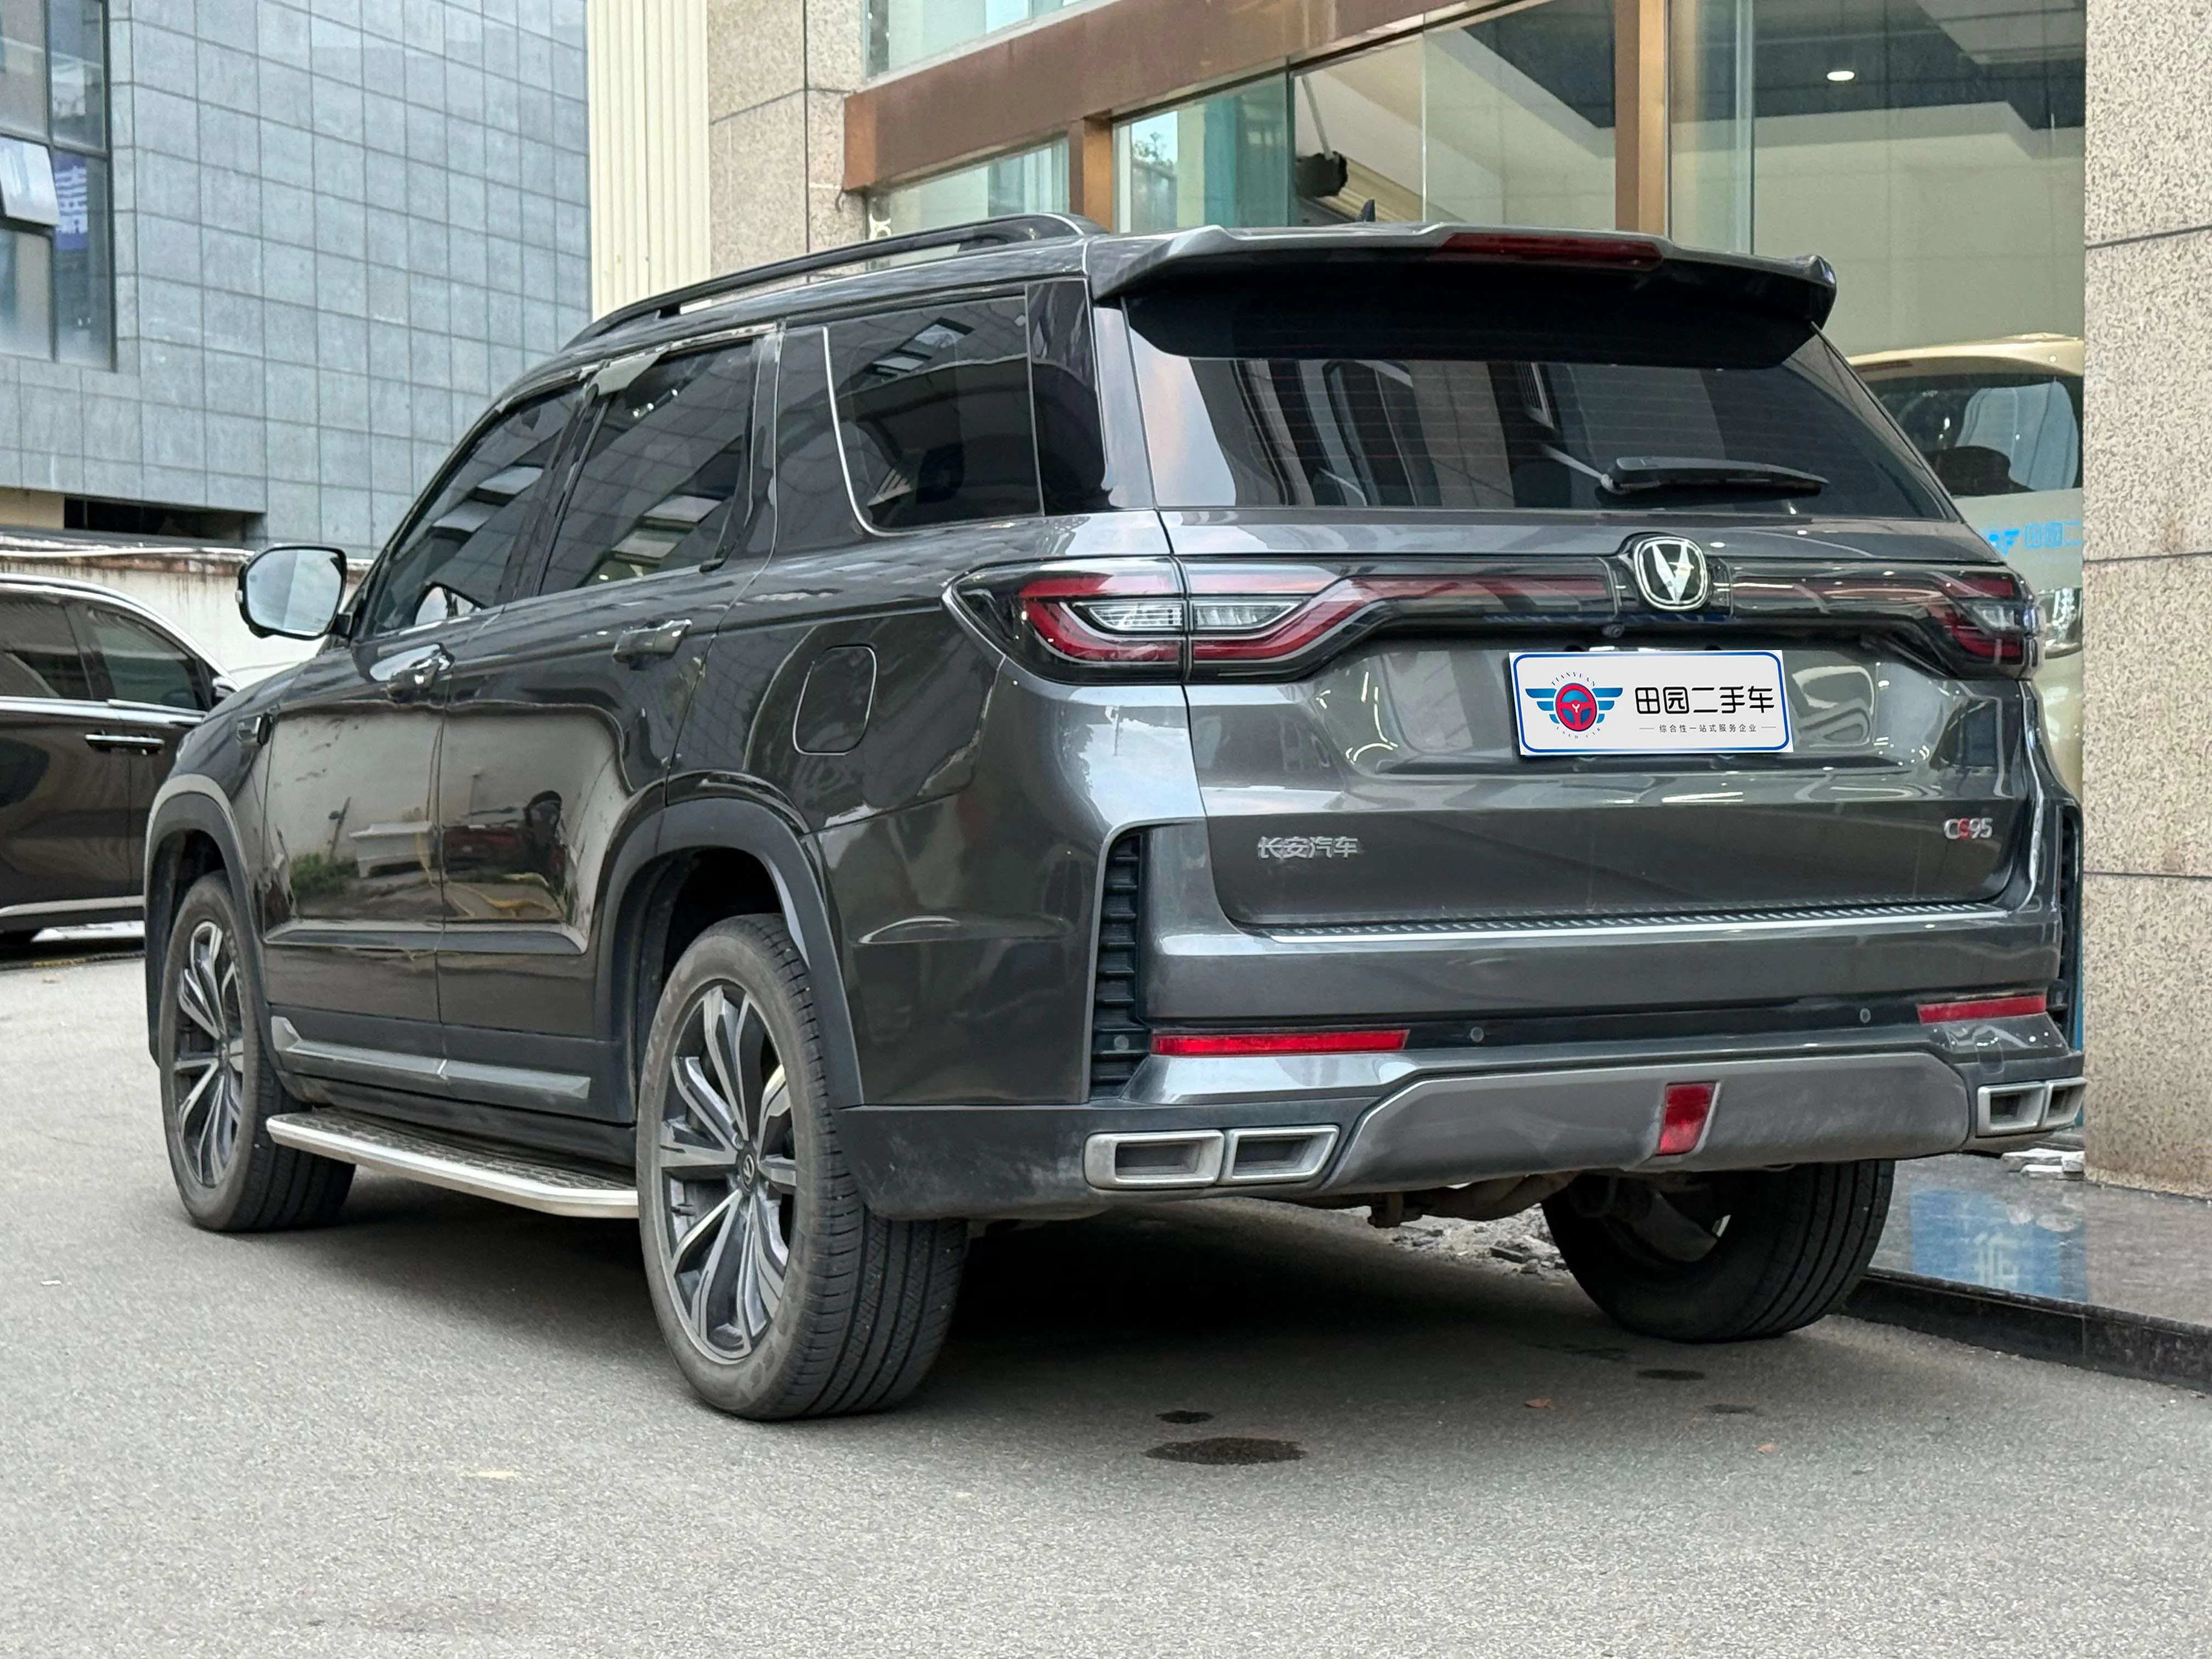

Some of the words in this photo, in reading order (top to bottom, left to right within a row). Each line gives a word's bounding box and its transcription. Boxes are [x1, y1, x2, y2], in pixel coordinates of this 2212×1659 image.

[1944, 817, 1994, 840] CS95
[1257, 836, 1359, 859] 长安汽车
